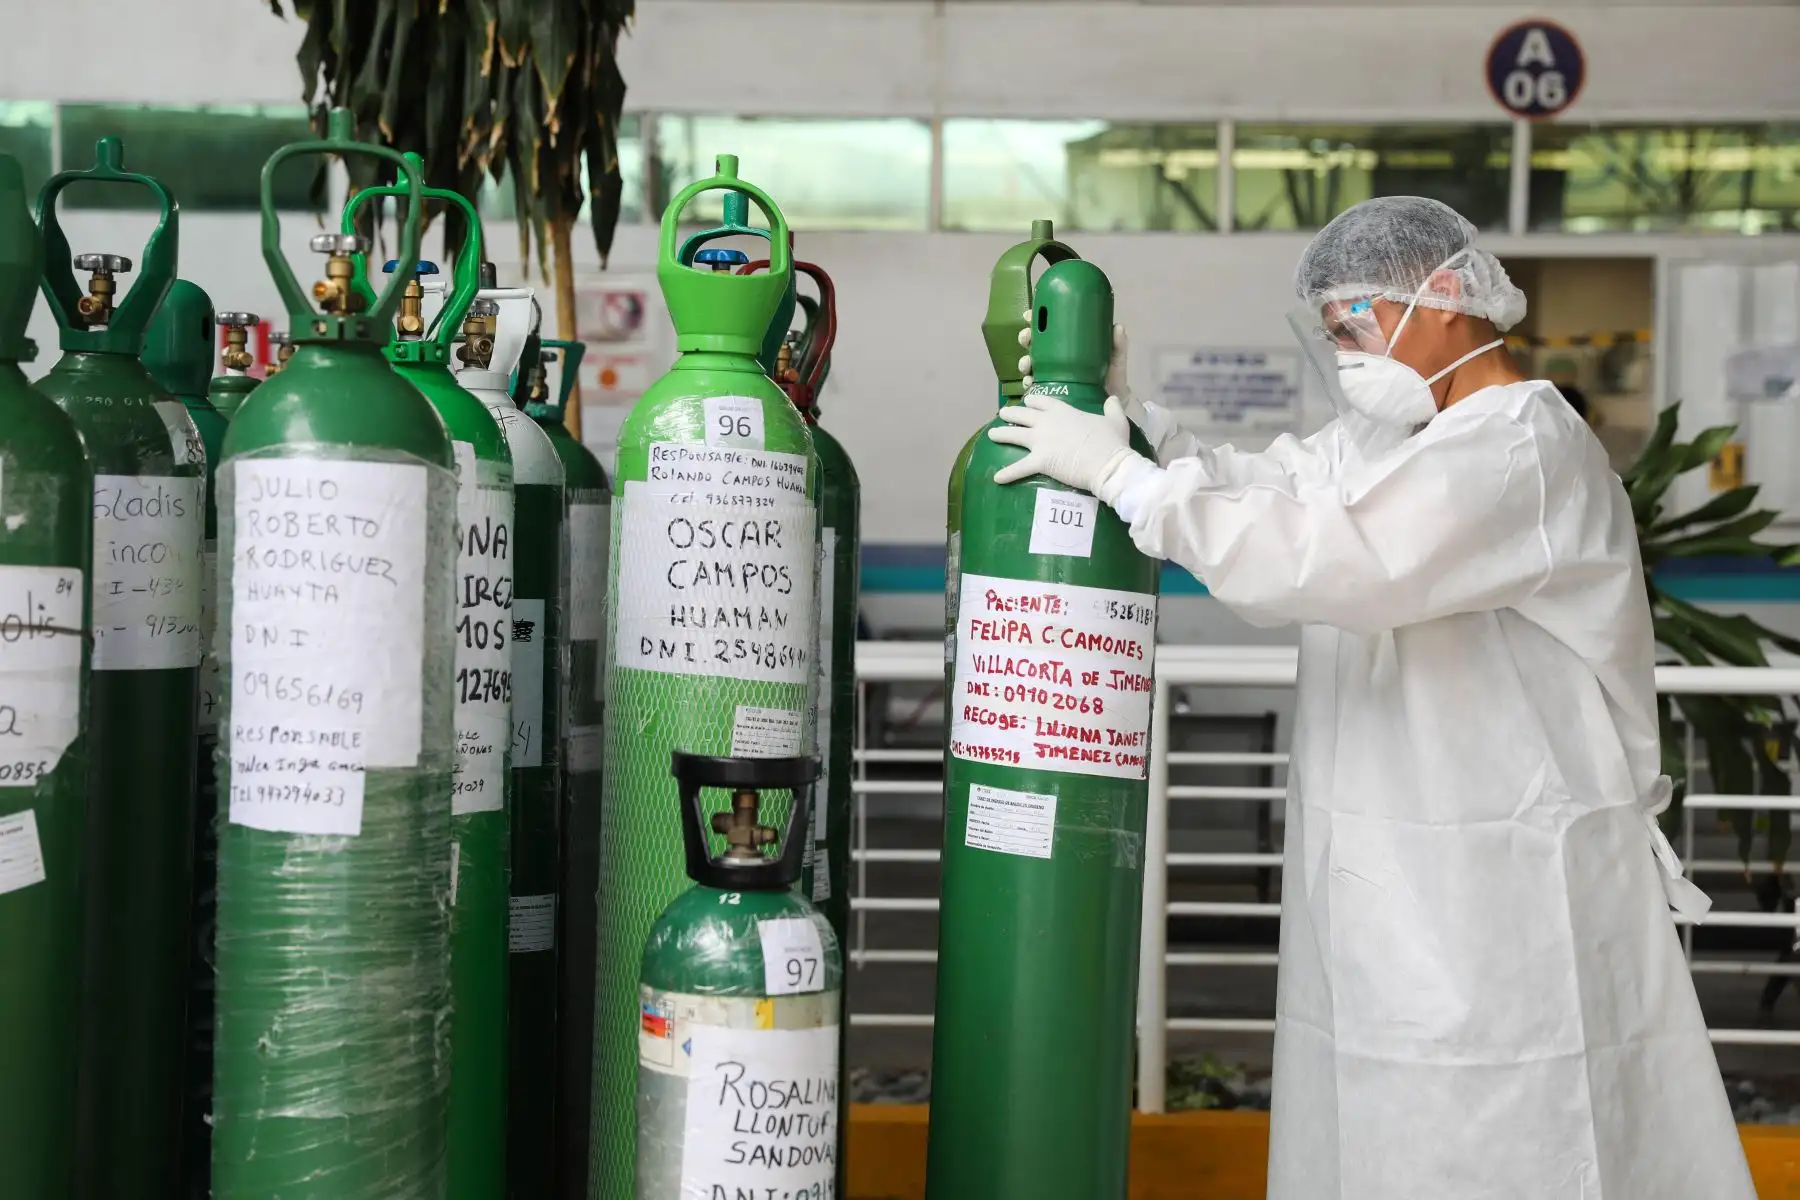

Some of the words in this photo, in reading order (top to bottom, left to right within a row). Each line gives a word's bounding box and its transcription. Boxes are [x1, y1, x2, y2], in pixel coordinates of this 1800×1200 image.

[1516, 28, 1555, 67] A
[1504, 69, 1567, 110] 06
[718, 415, 751, 437] 96
[250, 476, 338, 502] JULIO
[722, 471, 770, 488] CAMPOS
[249, 509, 379, 539] ROBERTO
[1049, 508, 1084, 528] 101
[667, 517, 782, 549] OSCAR
[246, 546, 397, 587] RODRIGUEZ
[667, 559, 793, 595] CAMPOS
[247, 581, 339, 604] HUAYTA
[985, 589, 1069, 615] PACIENTE:
[670, 604, 789, 632] HUAMAN
[1061, 628, 1143, 660] CAMONES
[243, 671, 364, 714] 09656169
[1081, 671, 1100, 686] DE
[1107, 728, 1146, 747] JANET
[1033, 743, 1112, 763] JIMENEZ
[787, 958, 818, 986] 97
